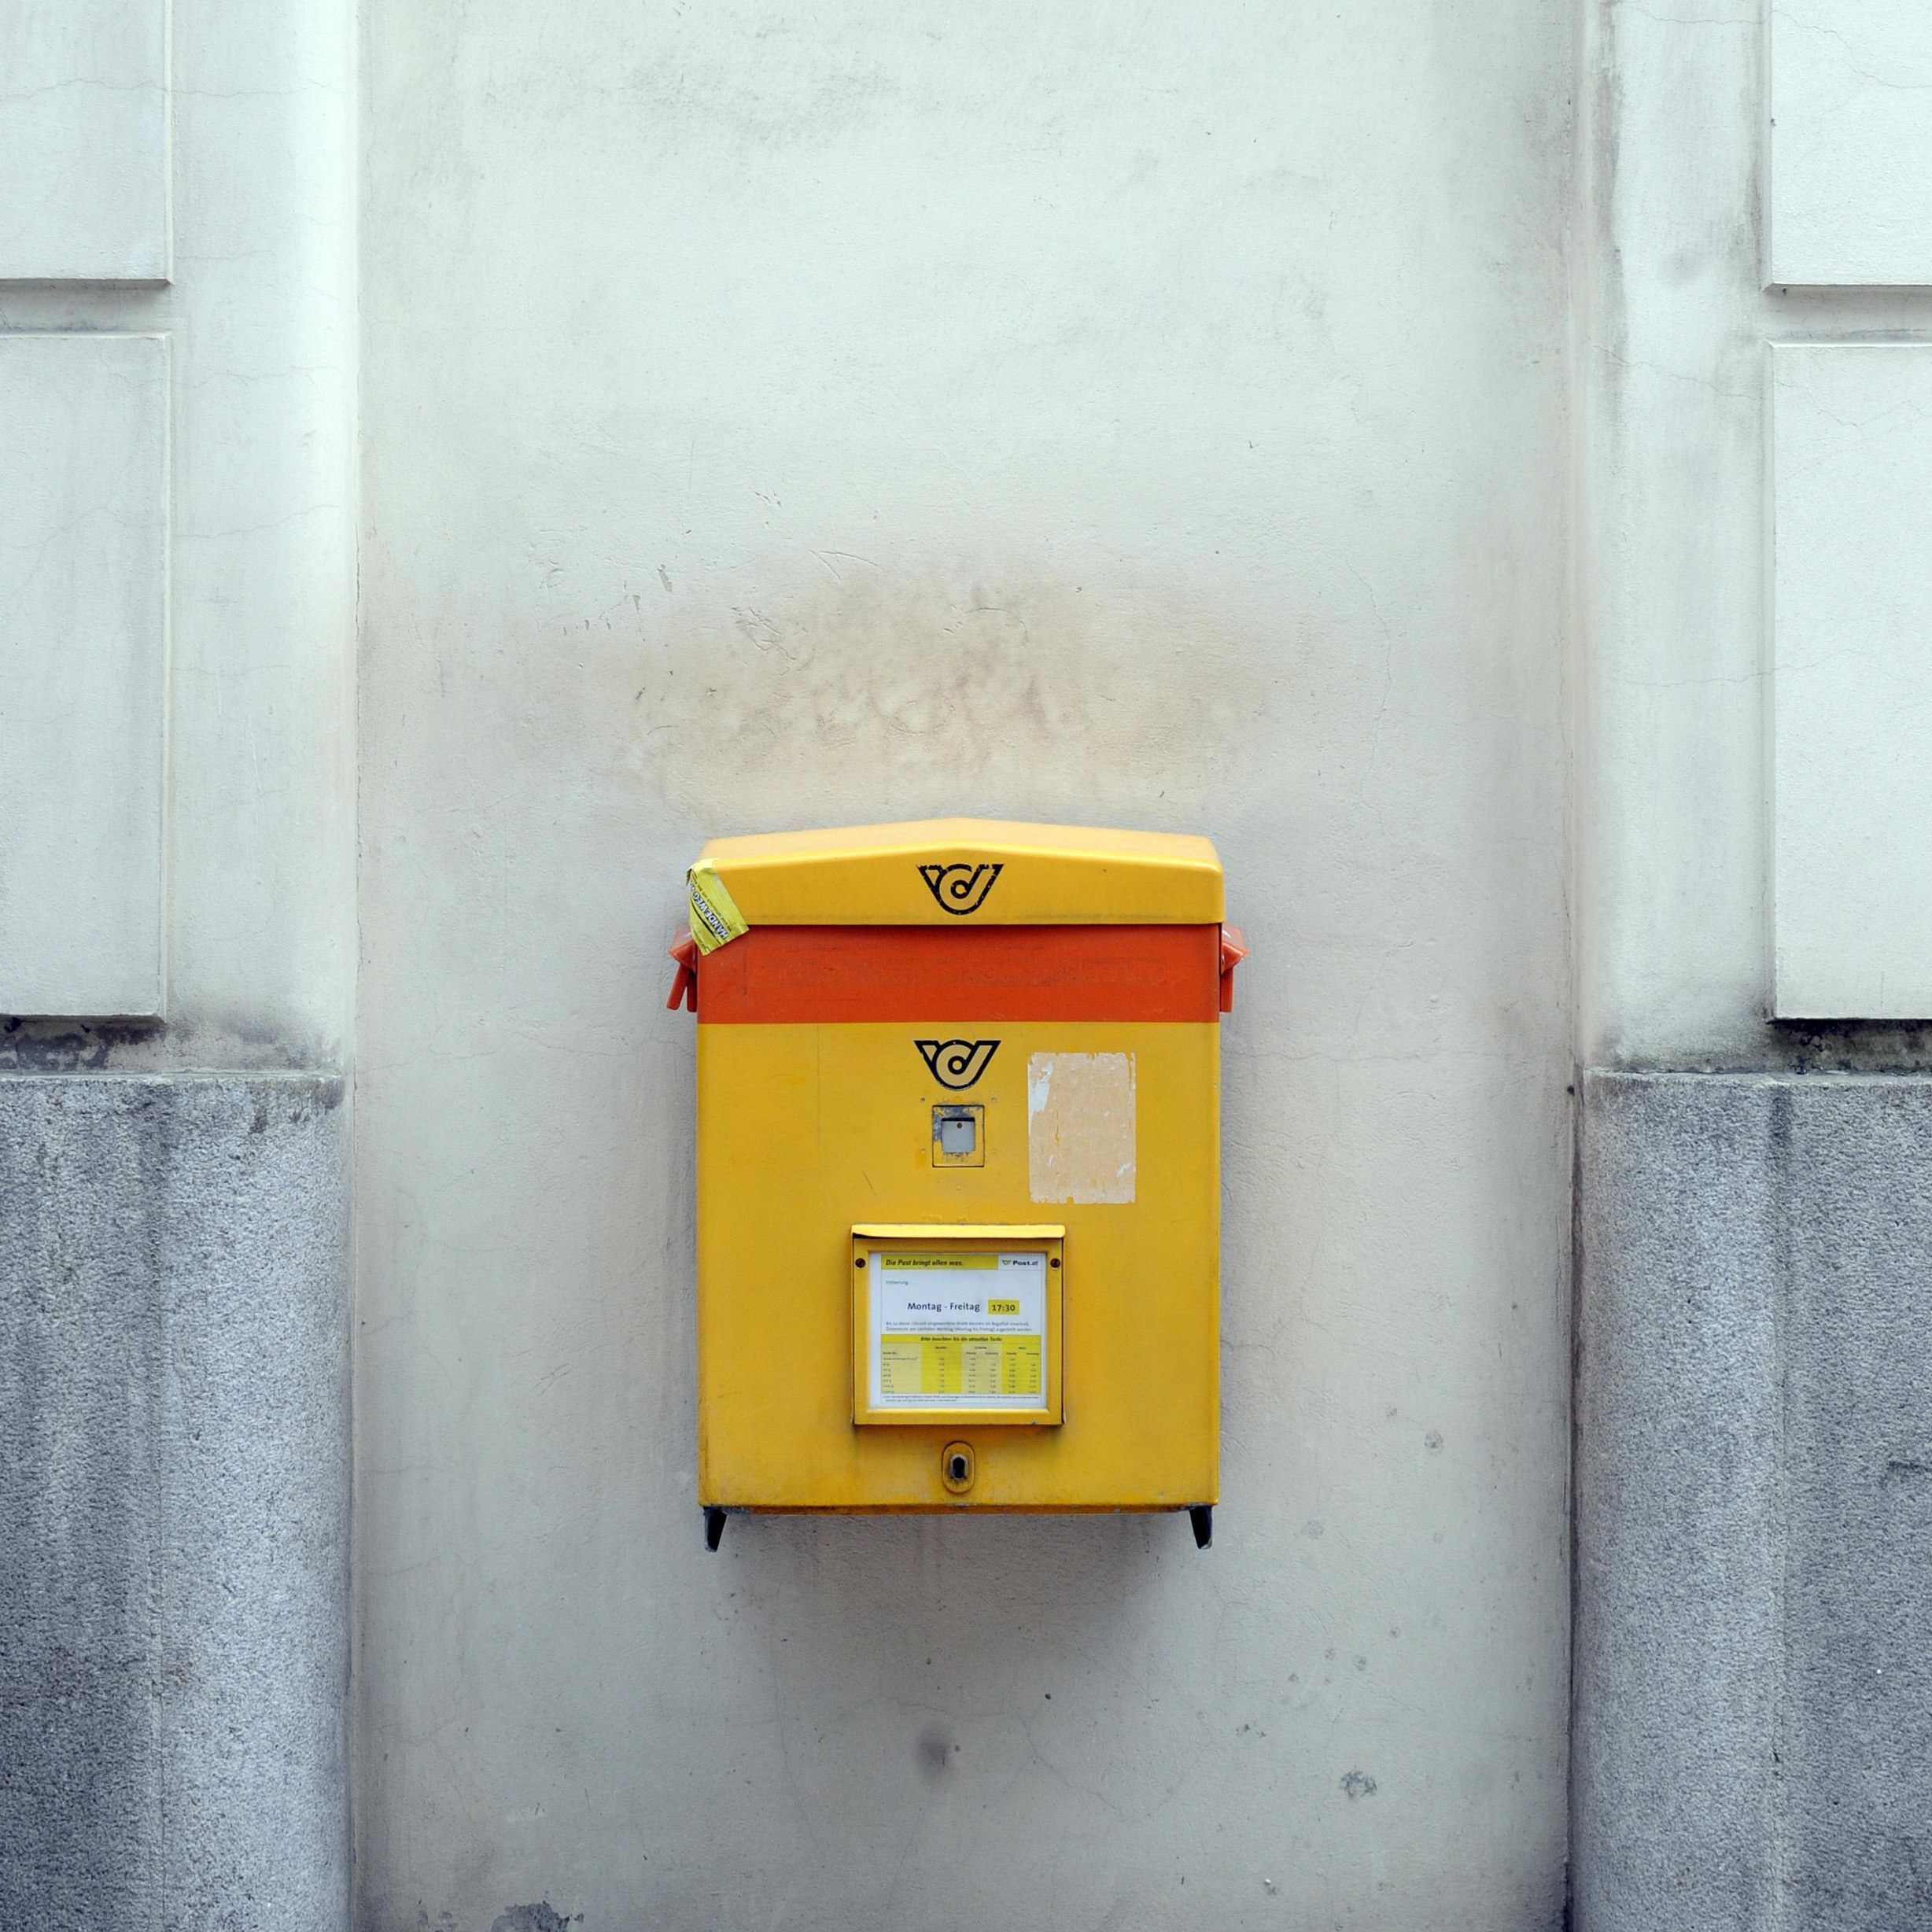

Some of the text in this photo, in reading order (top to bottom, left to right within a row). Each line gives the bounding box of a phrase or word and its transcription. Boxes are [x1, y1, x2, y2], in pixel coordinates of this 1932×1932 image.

[907, 1302, 942, 1312] Montag
[949, 1302, 980, 1312] Freitag
[991, 1303, 1016, 1312] 17:30
